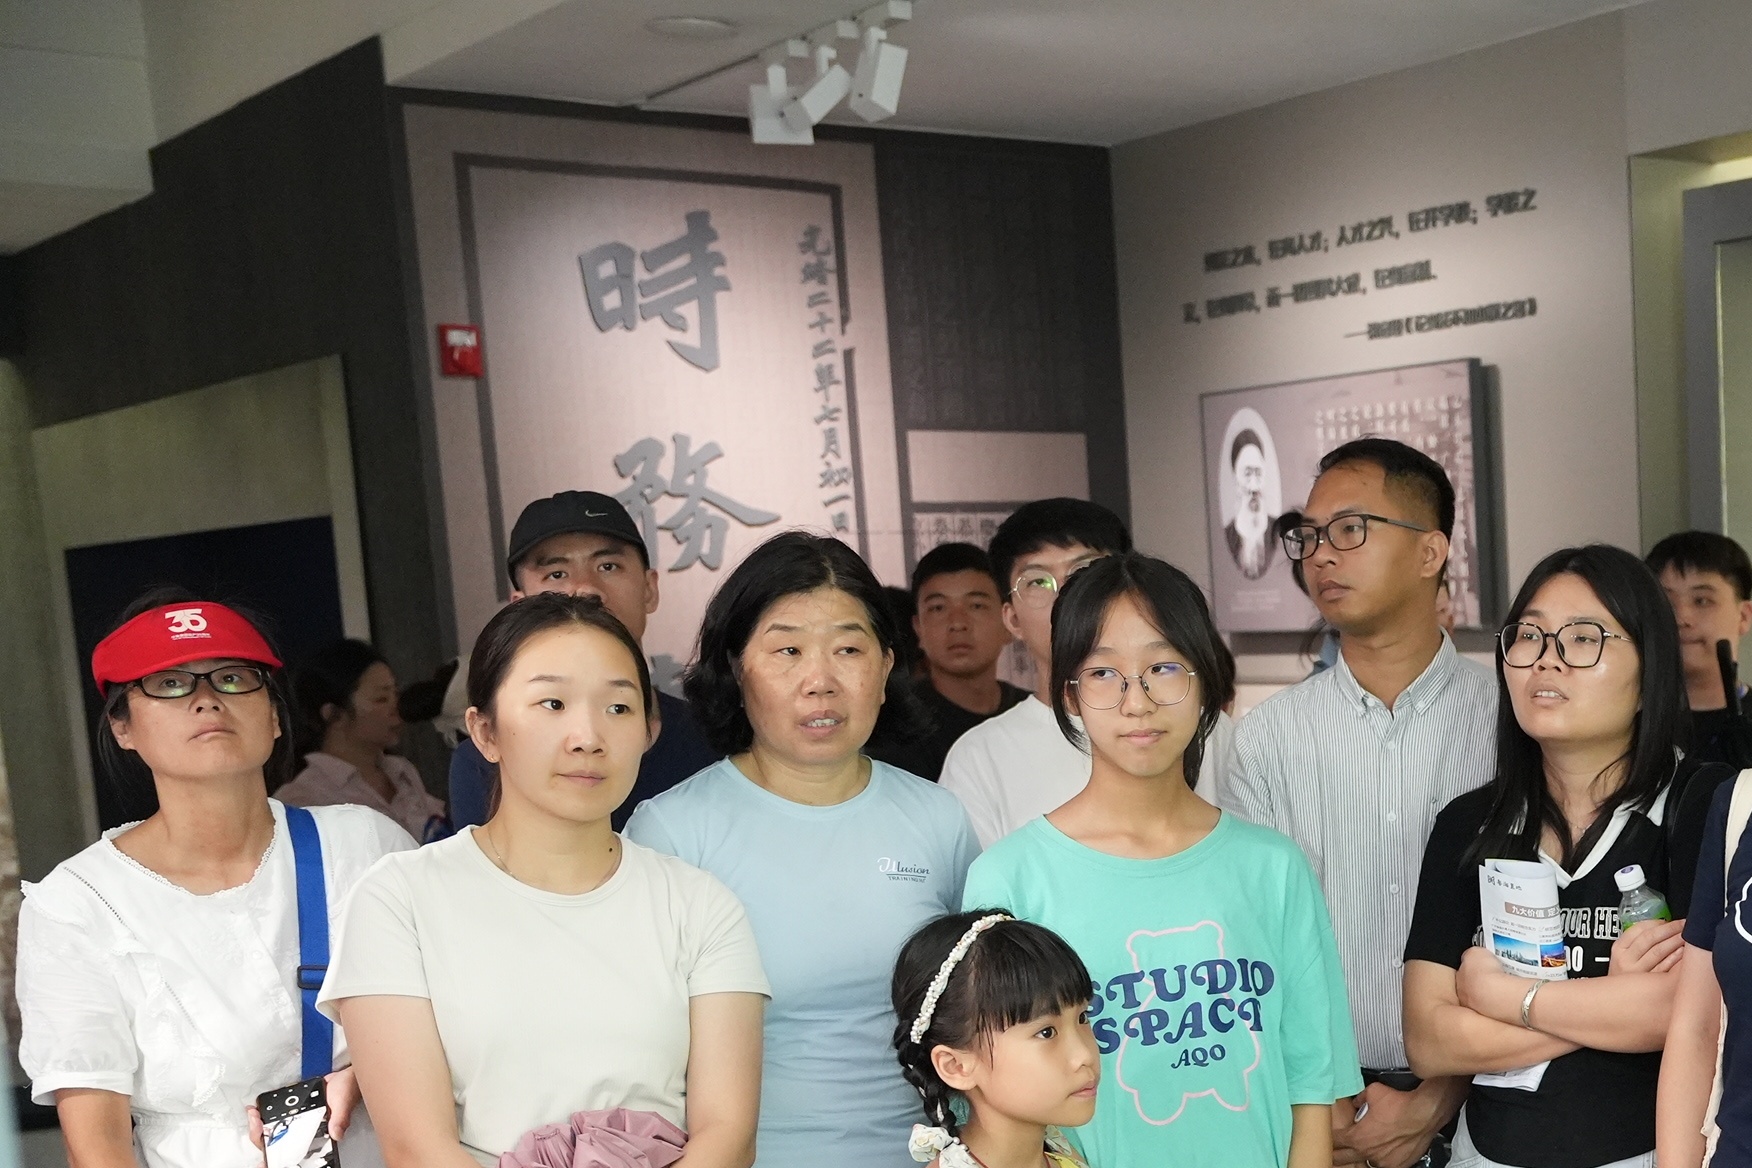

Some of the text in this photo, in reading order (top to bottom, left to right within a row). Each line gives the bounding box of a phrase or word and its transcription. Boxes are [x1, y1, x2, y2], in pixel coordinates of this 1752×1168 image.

[1511, 904, 1546, 918] 九大价值
[1170, 1043, 1227, 1069] AQO
